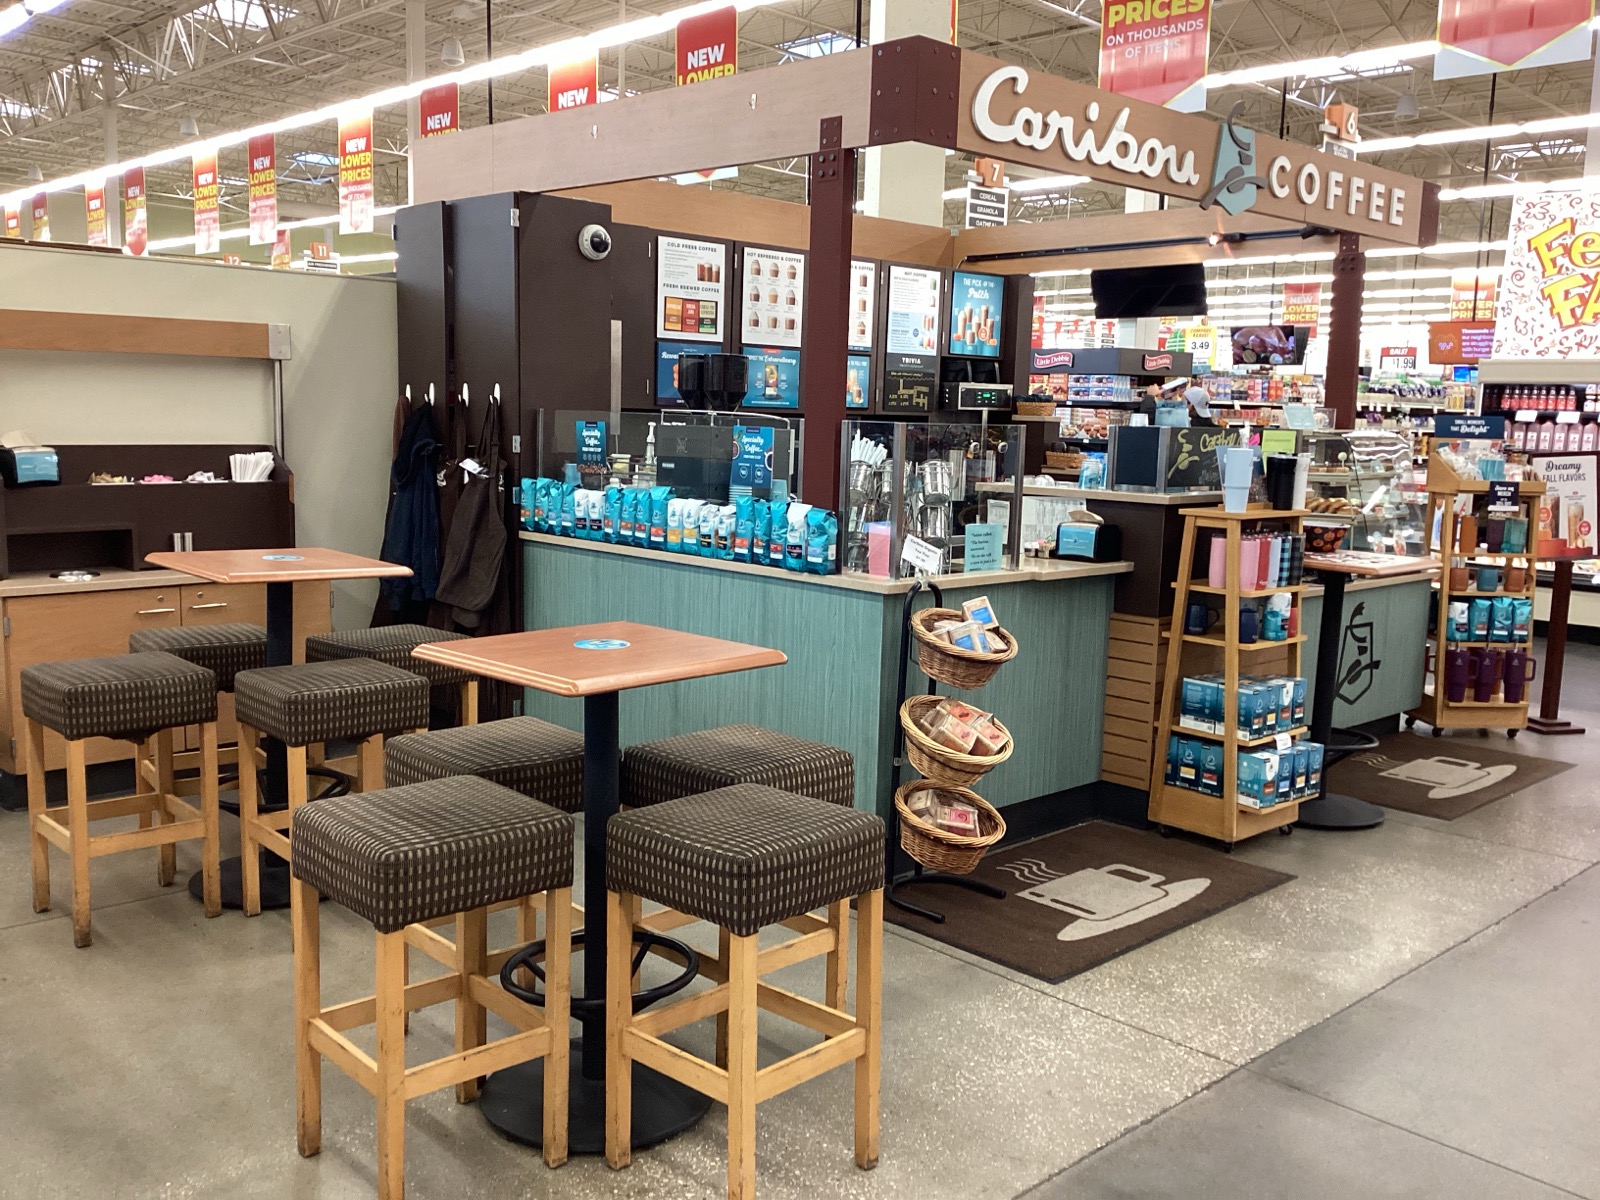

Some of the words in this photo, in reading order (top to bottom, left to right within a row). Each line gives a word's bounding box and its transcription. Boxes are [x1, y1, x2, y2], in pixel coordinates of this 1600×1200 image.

[1108, 0, 1204, 28] PRICES
[1106, 33, 1124, 47] ON
[1126, 18, 1204, 42] THOUSANDS
[687, 43, 725, 70] NEW
[1125, 47, 1140, 59] OF
[1144, 40, 1182, 55] ITEMS
[558, 87, 589, 110] NEW
[427, 111, 452, 130] NEW
[1347, 112, 1356, 134] 6
[345, 136, 367, 154] NEW
[972, 65, 1200, 186] Caribou
[1268, 155, 1406, 226] COFFEE
[253, 155, 271, 171] NEW
[340, 151, 371, 169] LOWER
[198, 172, 214, 186] NEW
[250, 169, 275, 184] LOWER
[341, 167, 371, 183] PRICES
[992, 163, 1000, 182] 7
[195, 184, 217, 199] LOWER
[251, 183, 275, 199] PRICES
[979, 192, 997, 201] CEREAL
[196, 197, 217, 211] PRICES
[976, 206, 998, 216] GRANOLA
[318, 245, 327, 257] 11
[228, 256, 239, 266] 12
[1289, 295, 1314, 304] NEW
[1452, 300, 1494, 309] LOWER
[1283, 304, 1319, 313] LOWER
[1283, 313, 1318, 322] PRICES
[1191, 341, 1210, 350] 3.49
[1051, 355, 1070, 363] Debbie
[742, 435, 764, 446] Specialty
[744, 443, 763, 454] Coffee
[1545, 461, 1581, 473] Dreamy
[1543, 474, 1558, 483] FALL
[1558, 473, 1586, 482] FLAVORS
